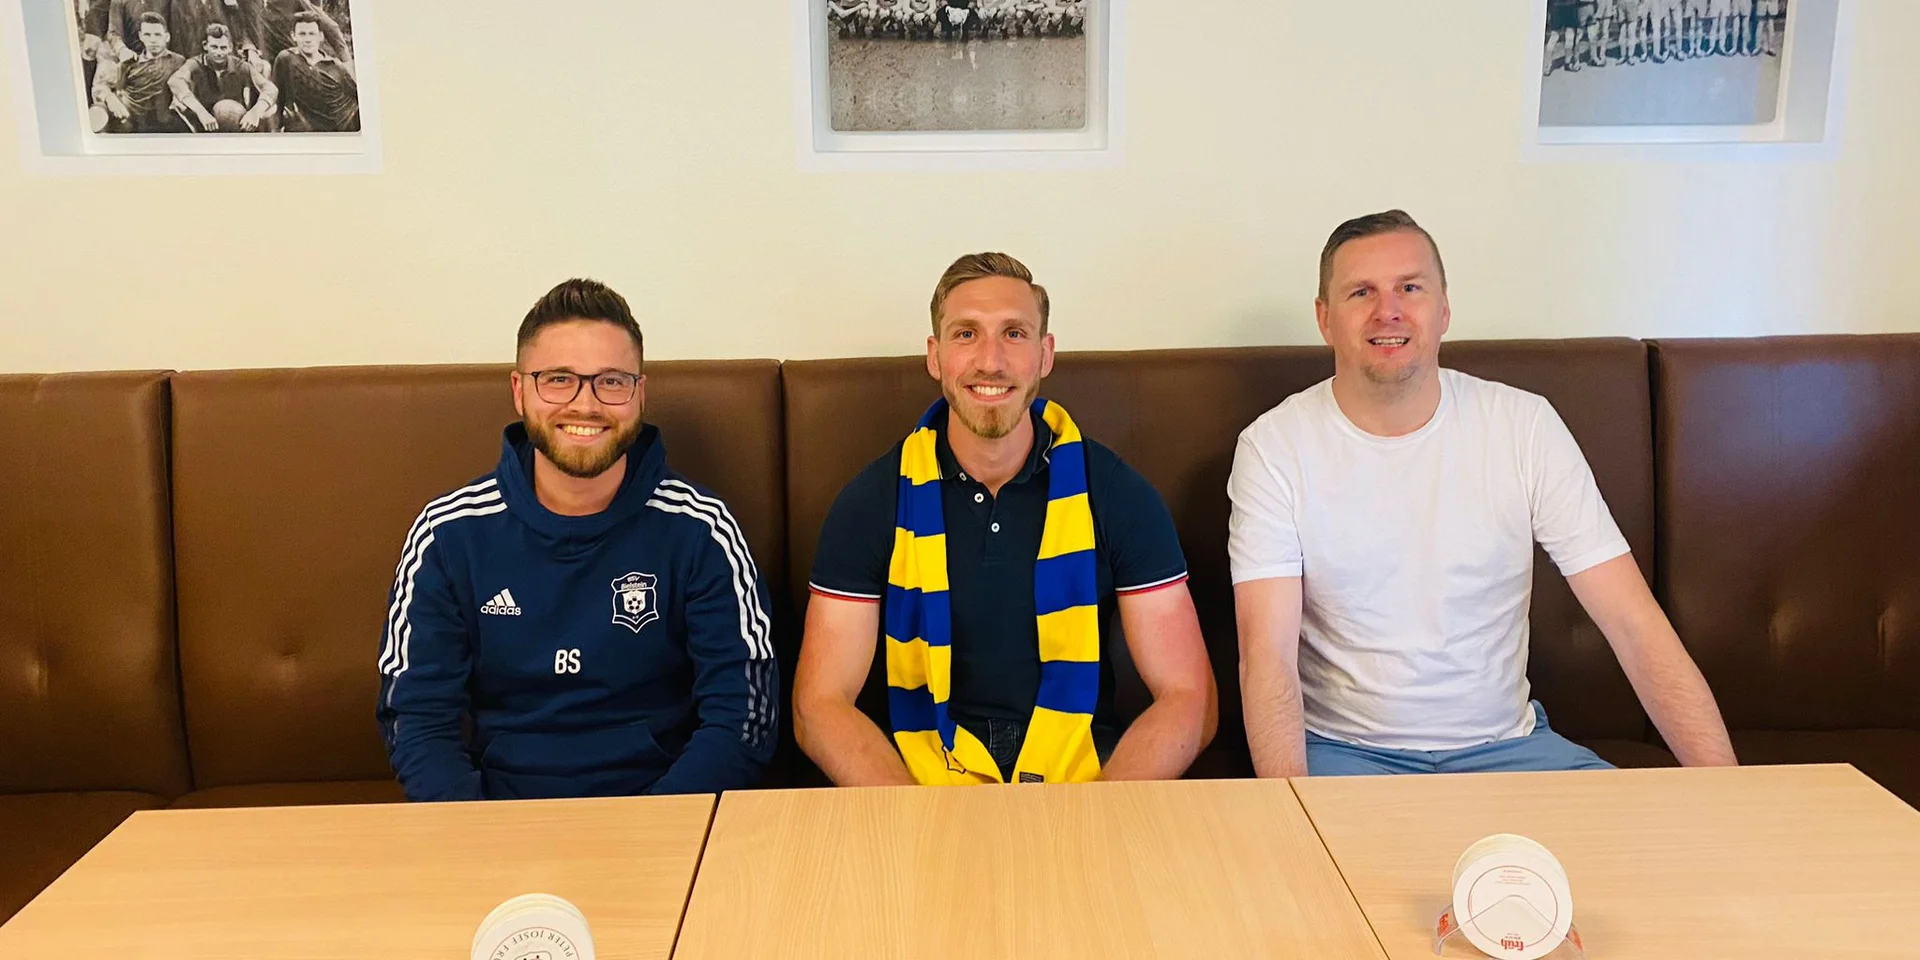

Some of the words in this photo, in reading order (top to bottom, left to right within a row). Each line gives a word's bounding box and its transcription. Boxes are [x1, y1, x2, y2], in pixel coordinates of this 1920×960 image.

[480, 605, 522, 616] adidas
[554, 648, 581, 675] BS
[512, 930, 544, 944] JOSEF
[547, 934, 574, 957] PETER
[1501, 939, 1524, 951] früh
